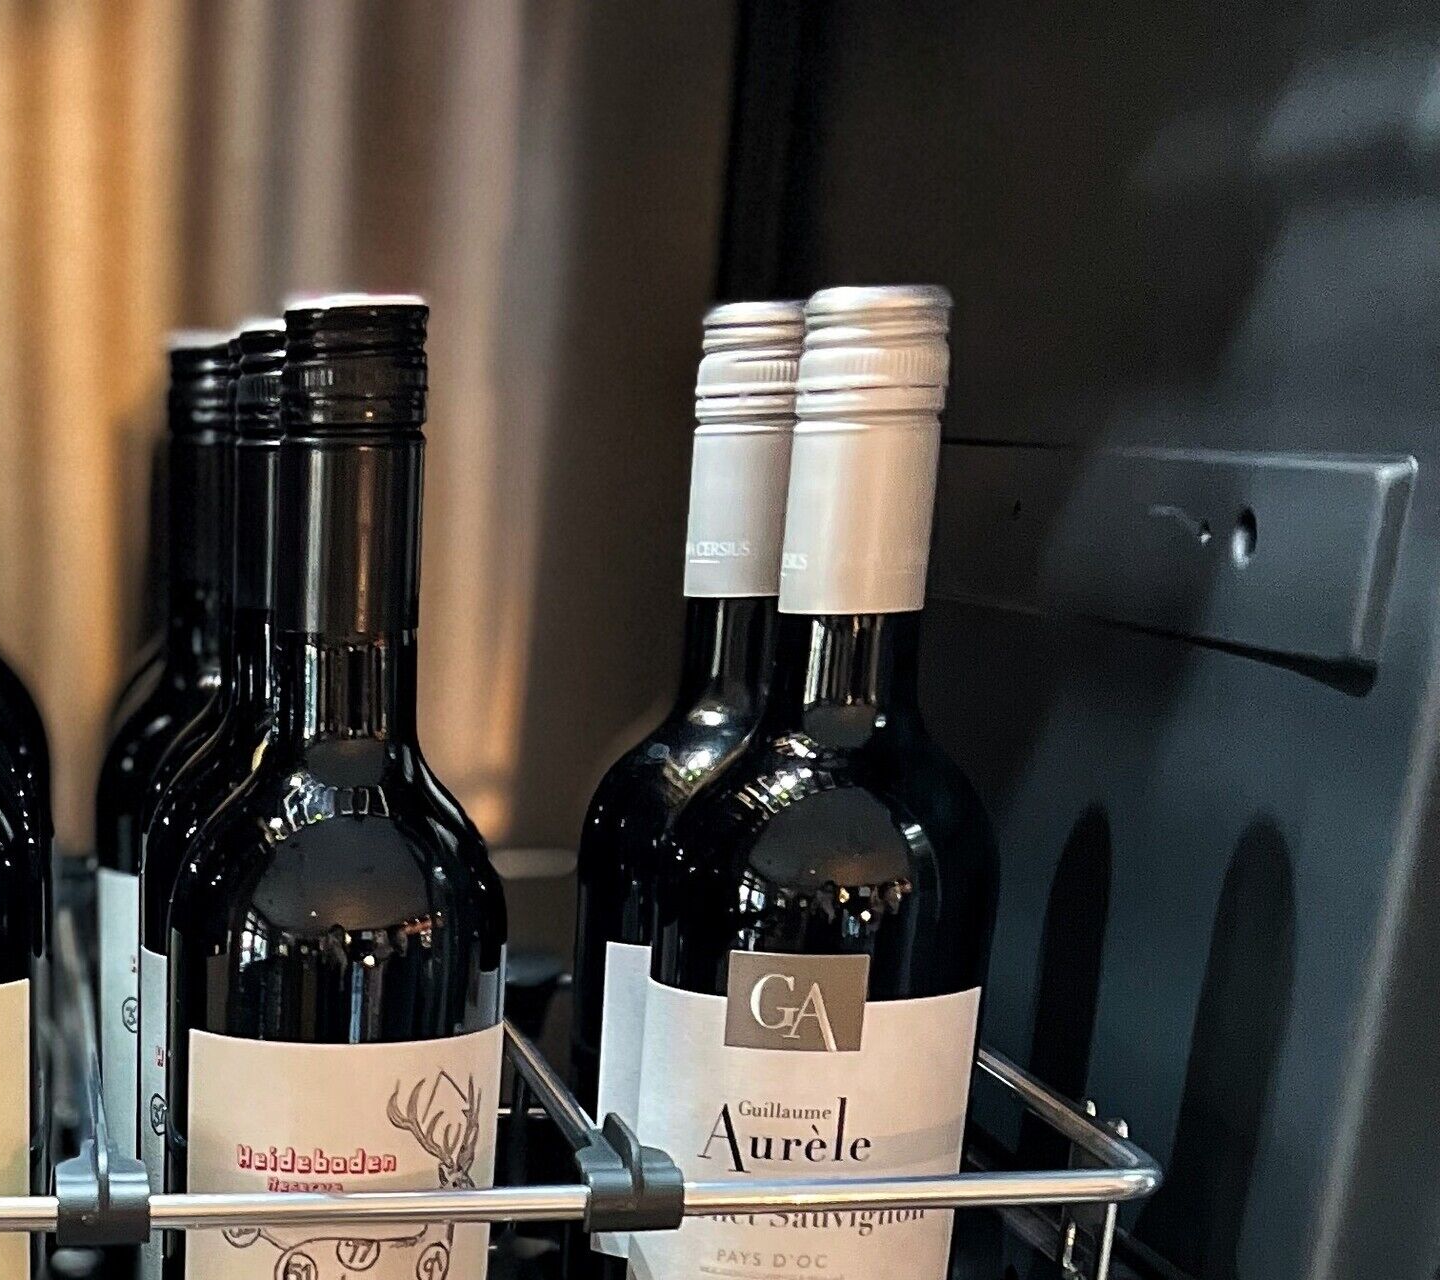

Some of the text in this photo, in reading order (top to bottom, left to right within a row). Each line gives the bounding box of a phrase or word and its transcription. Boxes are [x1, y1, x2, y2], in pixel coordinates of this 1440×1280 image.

[750, 973, 837, 1052] GA
[738, 1100, 831, 1120] Guillaume
[698, 1097, 871, 1174] Aurèle
[236, 1143, 398, 1174] Heideboden
[716, 1248, 828, 1269] PAYS D'OC
